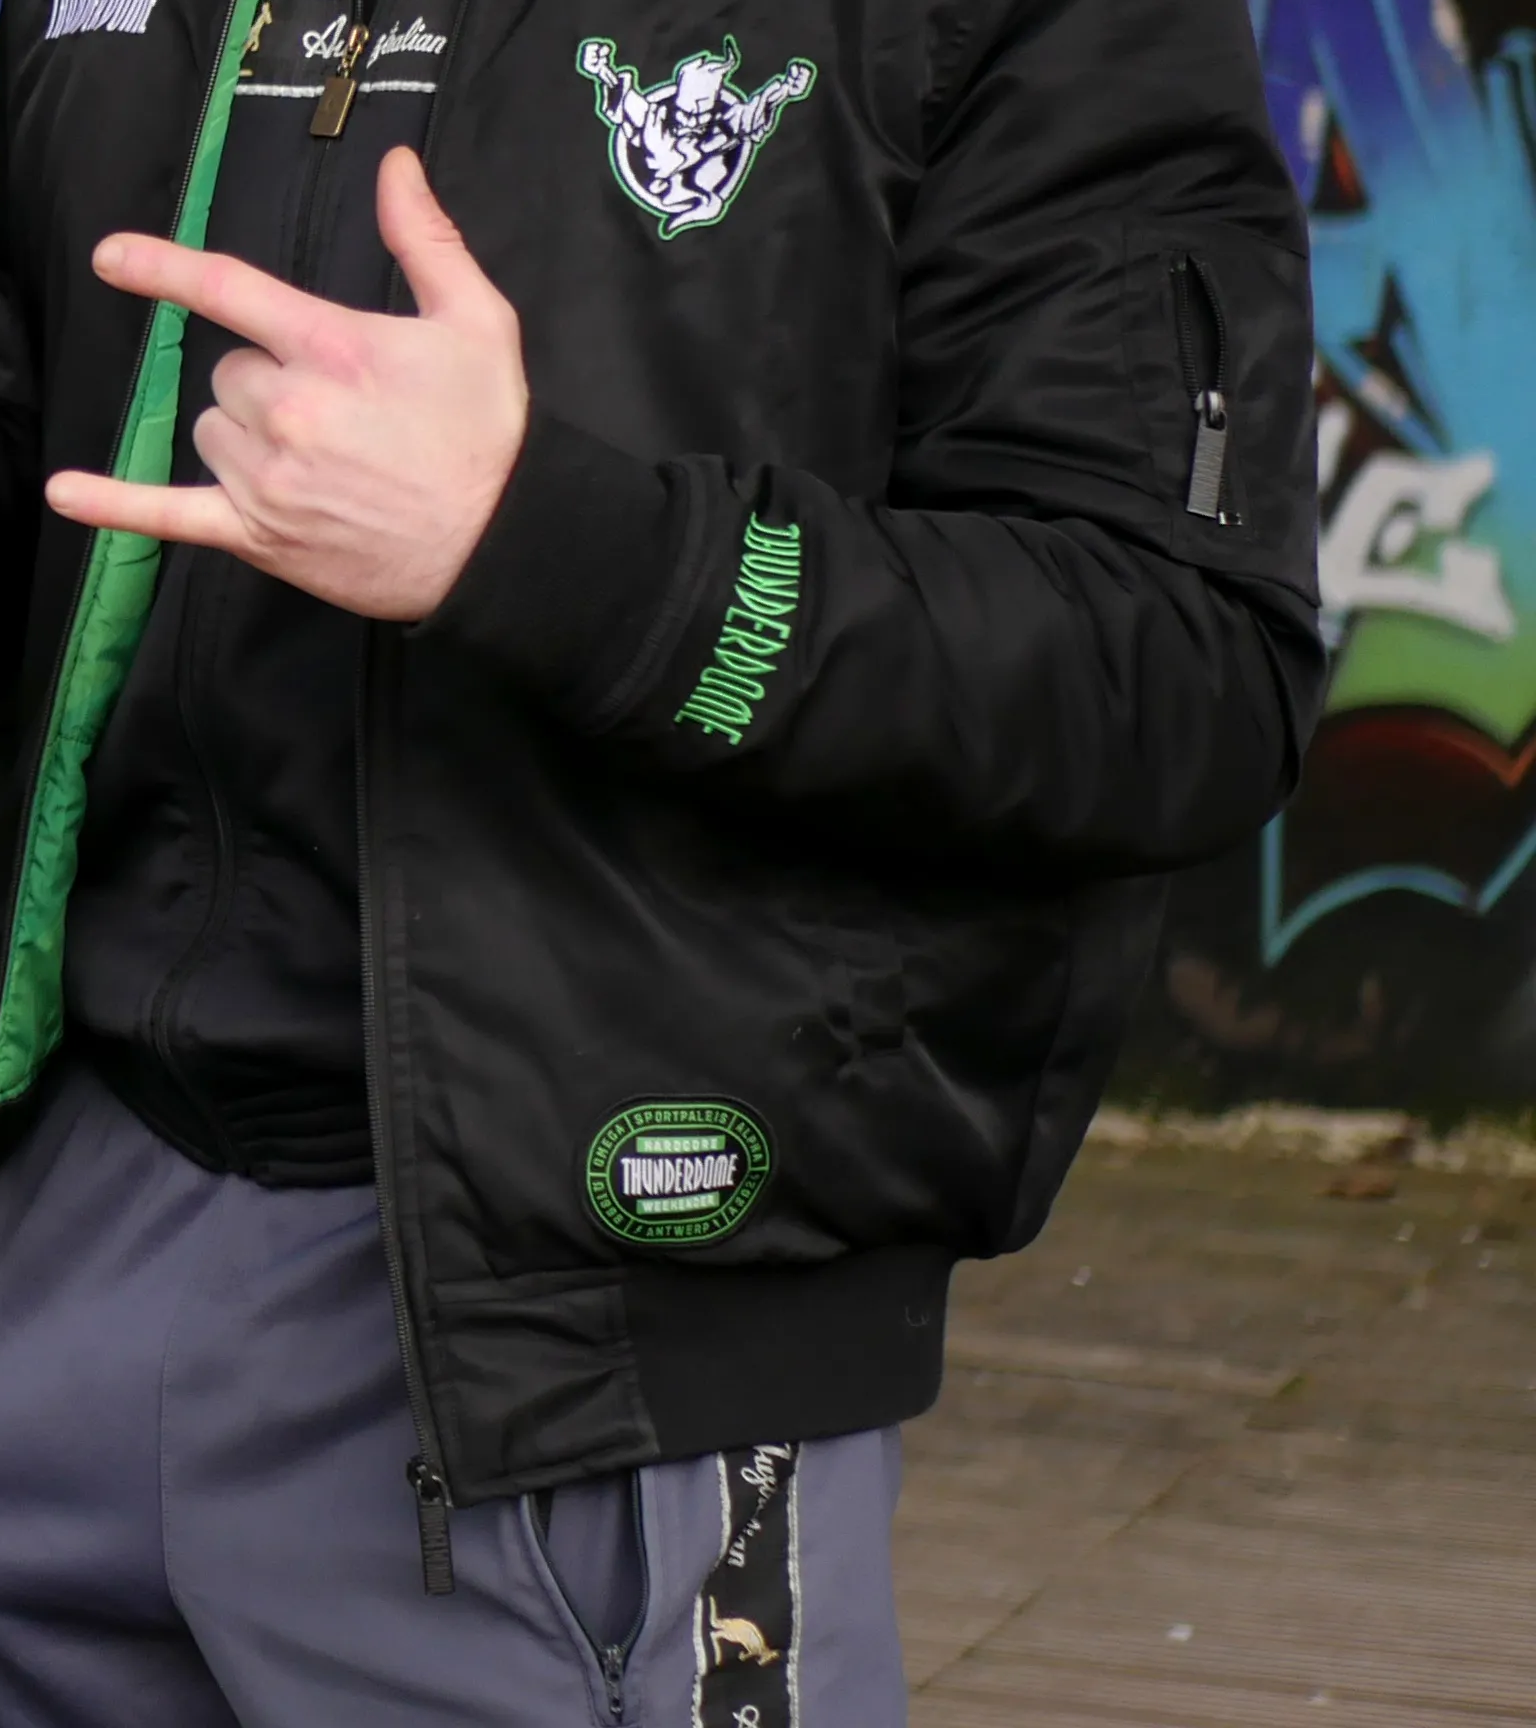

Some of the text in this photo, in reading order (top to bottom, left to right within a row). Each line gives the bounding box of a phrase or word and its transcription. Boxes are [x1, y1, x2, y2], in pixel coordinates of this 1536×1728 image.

[674, 510, 802, 746] THUNDERDOME
[633, 1109, 730, 1125] SPORTPALEIS
[593, 1123, 626, 1168] OMEGA
[643, 1138, 719, 1153] HARDCORE
[735, 1121, 764, 1164] ALPHA
[620, 1152, 740, 1197] THUNDERDOME
[642, 1195, 716, 1213] WEEKENDER
[645, 1223, 711, 1238] ANTWERP
